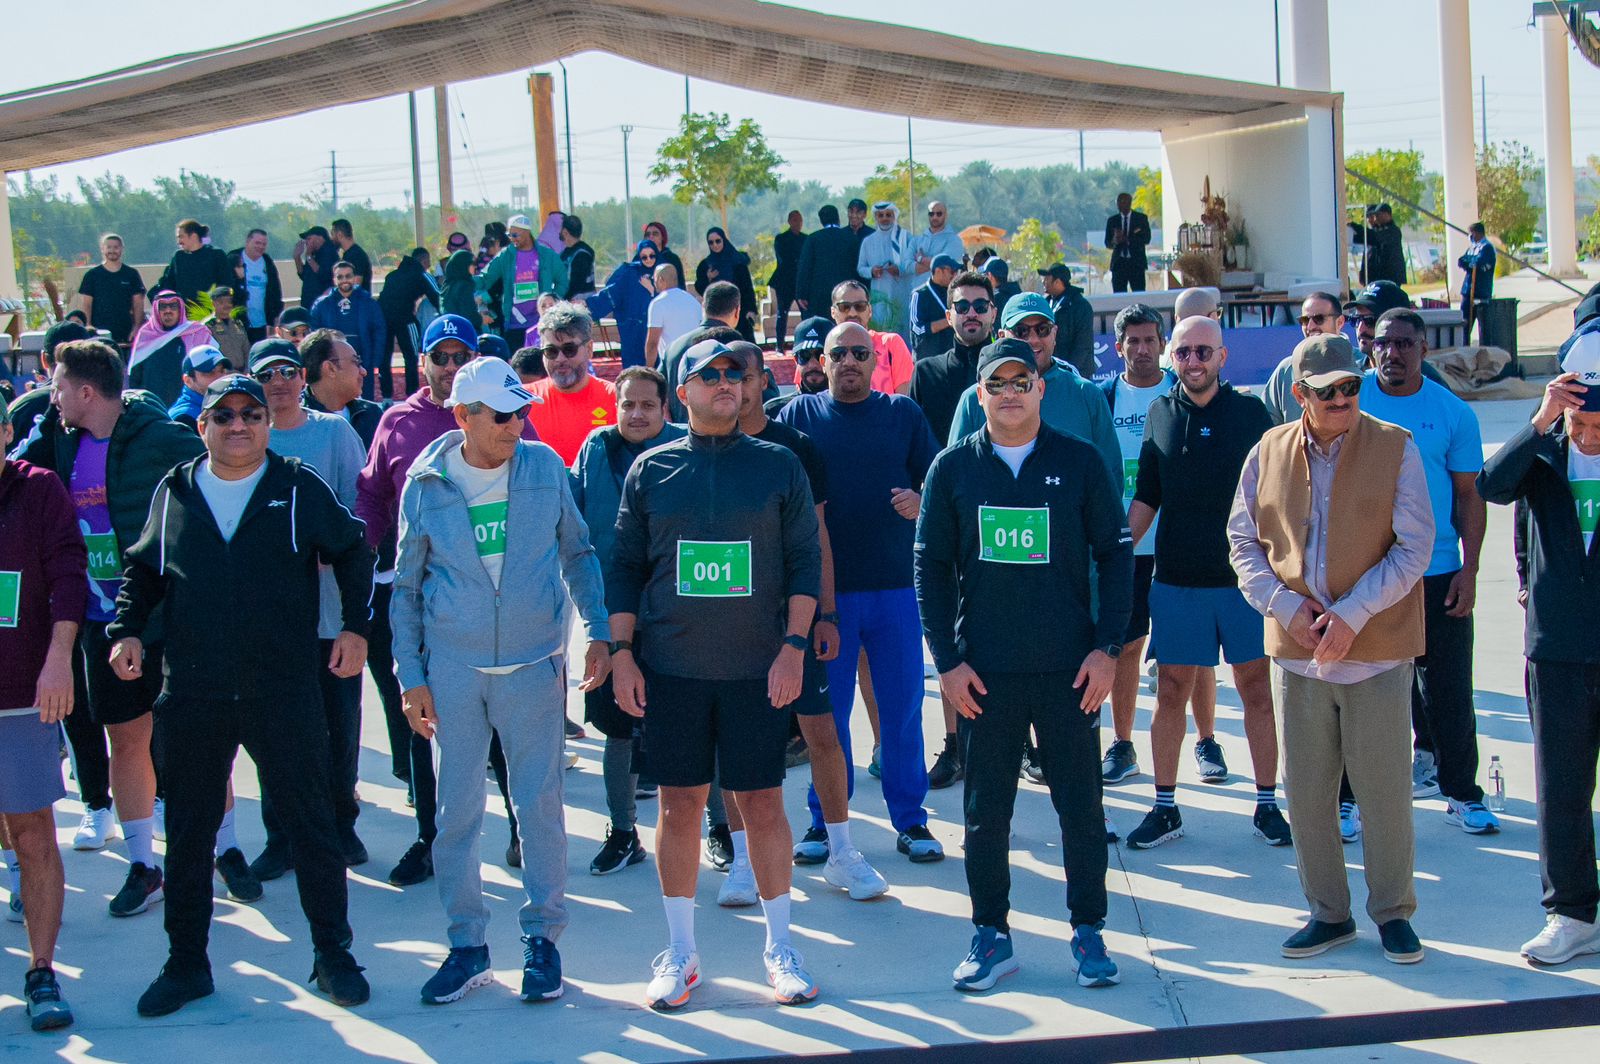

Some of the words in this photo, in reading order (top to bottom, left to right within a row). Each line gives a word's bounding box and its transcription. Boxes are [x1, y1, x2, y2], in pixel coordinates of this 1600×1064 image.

[443, 319, 457, 334] LA
[994, 527, 1034, 549] 016
[88, 551, 116, 568] 014
[693, 562, 732, 582] 001
